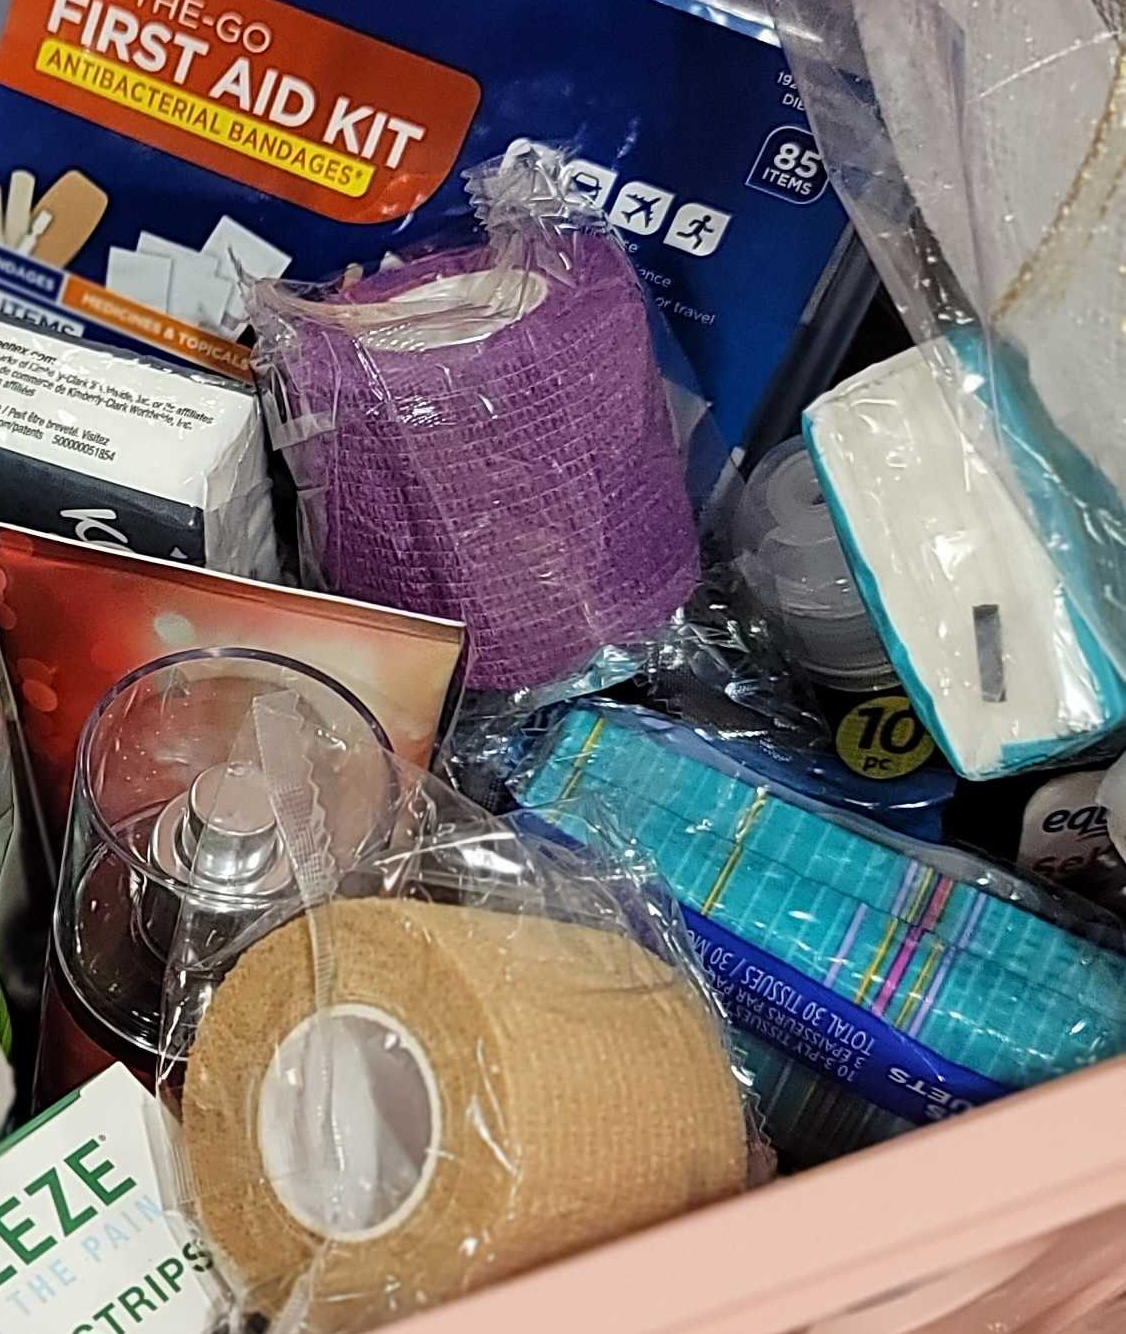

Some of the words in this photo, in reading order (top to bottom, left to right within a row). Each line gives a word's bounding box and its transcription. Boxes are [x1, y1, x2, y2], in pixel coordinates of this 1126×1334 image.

[46, 47, 223, 135] ANTIBACTERIAL
[208, 57, 316, 128] AID
[323, 96, 425, 169] KIT
[773, 142, 822, 179] 85
[761, 169, 813, 196] ITEMS
[673, 301, 716, 326] travel
[857, 707, 925, 754] 10
[862, 757, 892, 771] pc
[708, 945, 732, 969] 30
[734, 987, 764, 1012] PAR
[739, 963, 805, 1014] TISSUES
[733, 1003, 791, 1046] TISSUES
[800, 1000, 826, 1026] 30
[820, 1012, 876, 1057] TOTAL
[792, 1038, 835, 1070] 3-PLY
[5, 1256, 79, 1320] THE
[84, 1191, 163, 1264] PAIN
